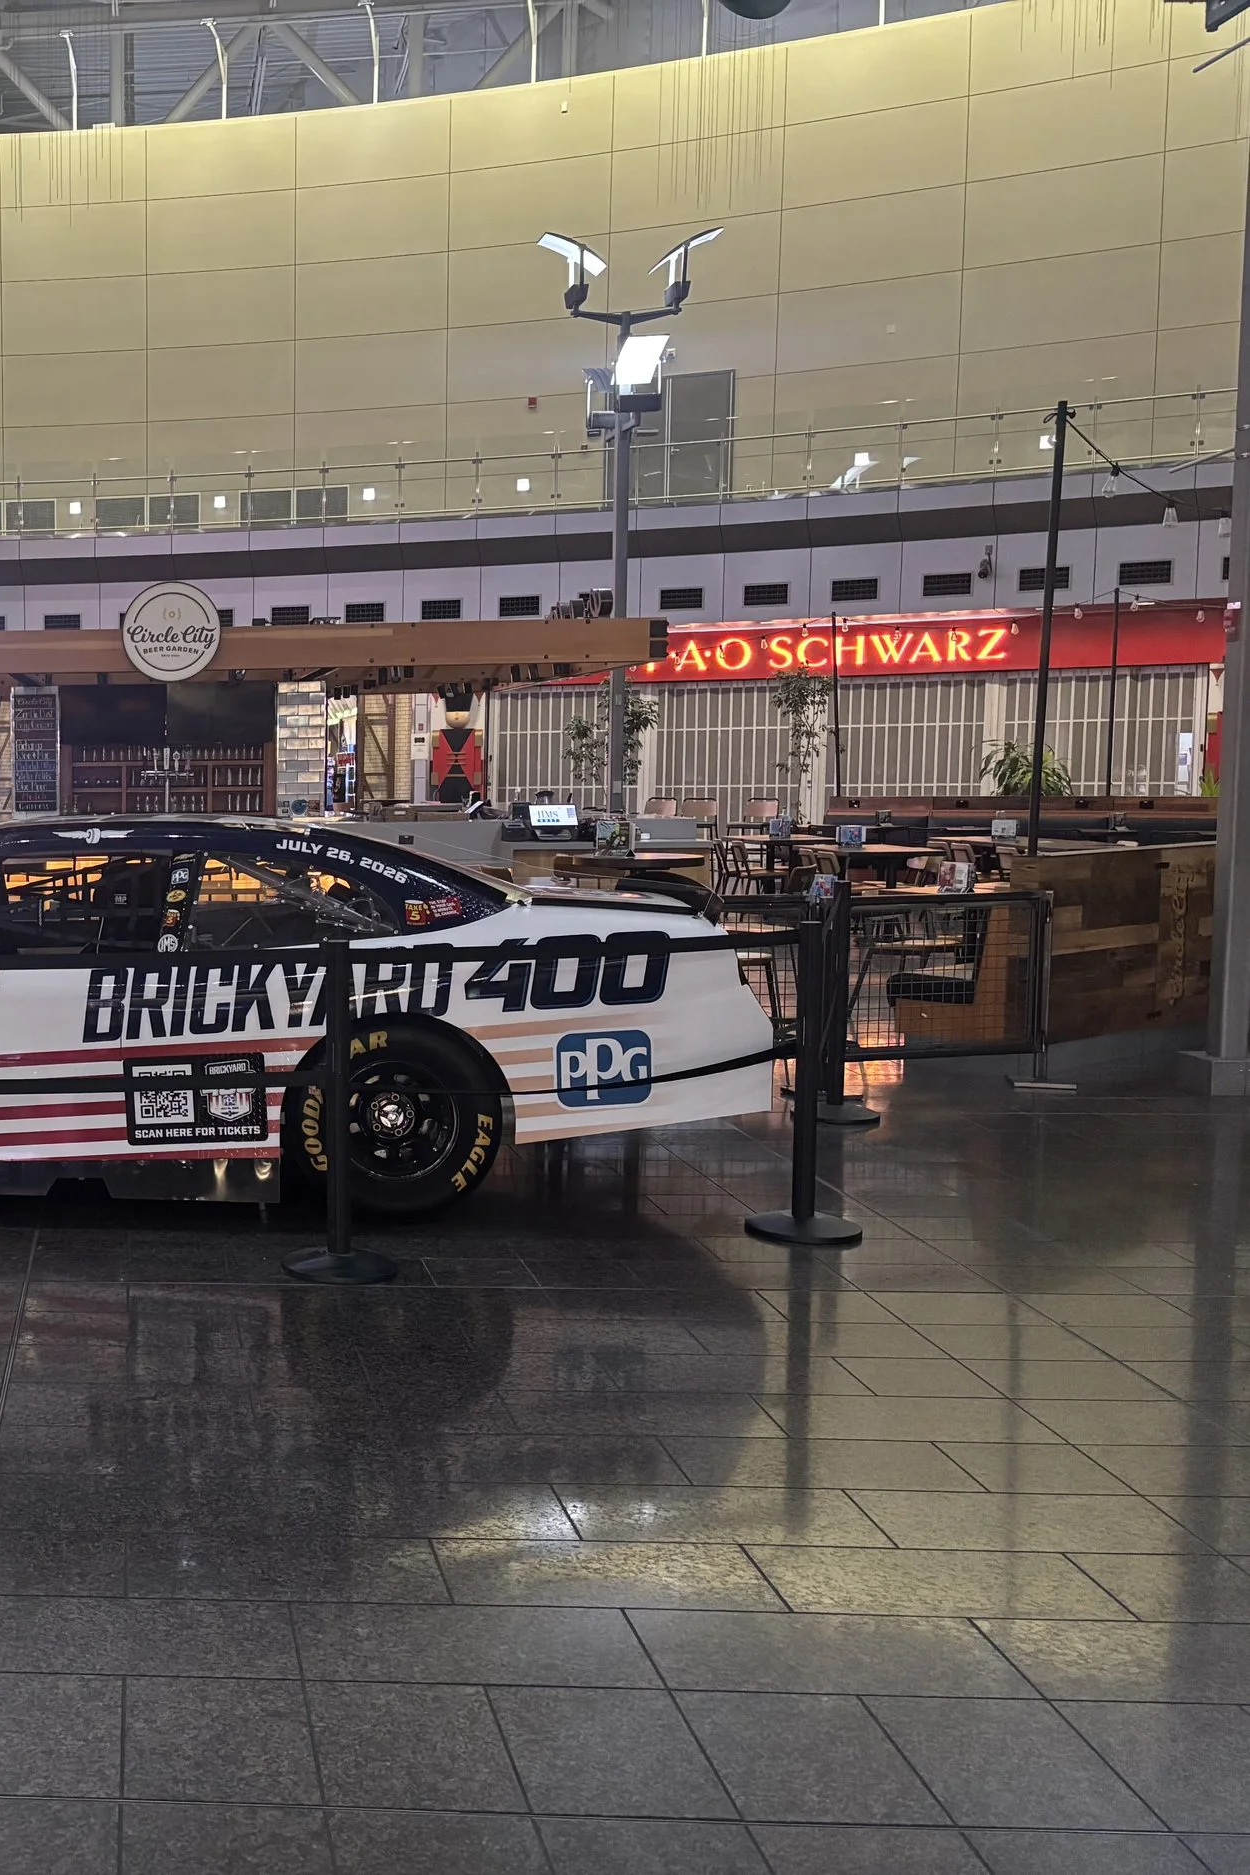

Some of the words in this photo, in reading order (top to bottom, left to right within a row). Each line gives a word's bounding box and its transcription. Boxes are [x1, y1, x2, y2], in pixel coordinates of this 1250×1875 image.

[127, 625, 180, 643] Circle
[181, 625, 217, 649] City
[143, 646, 164, 654] BEER
[166, 646, 199, 655] GARDEN
[768, 628, 1008, 668] SCHWARZ
[276, 839, 323, 855] JULY
[326, 846, 355, 865] 26,
[358, 856, 408, 884] 2026
[172, 870, 189, 882] PPG
[115, 895, 127, 903] MP
[410, 911, 421, 920] 5
[464, 930, 672, 1012] 400
[209, 1062, 247, 1076] BRICKYARD
[560, 1037, 648, 1100] PPG
[134, 1129, 163, 1139] SCAN
[165, 1127, 193, 1138] HERE
[195, 1127, 216, 1137] FOR
[218, 1125, 261, 1136] TICKETS
[451, 1113, 494, 1192] EAGLE
